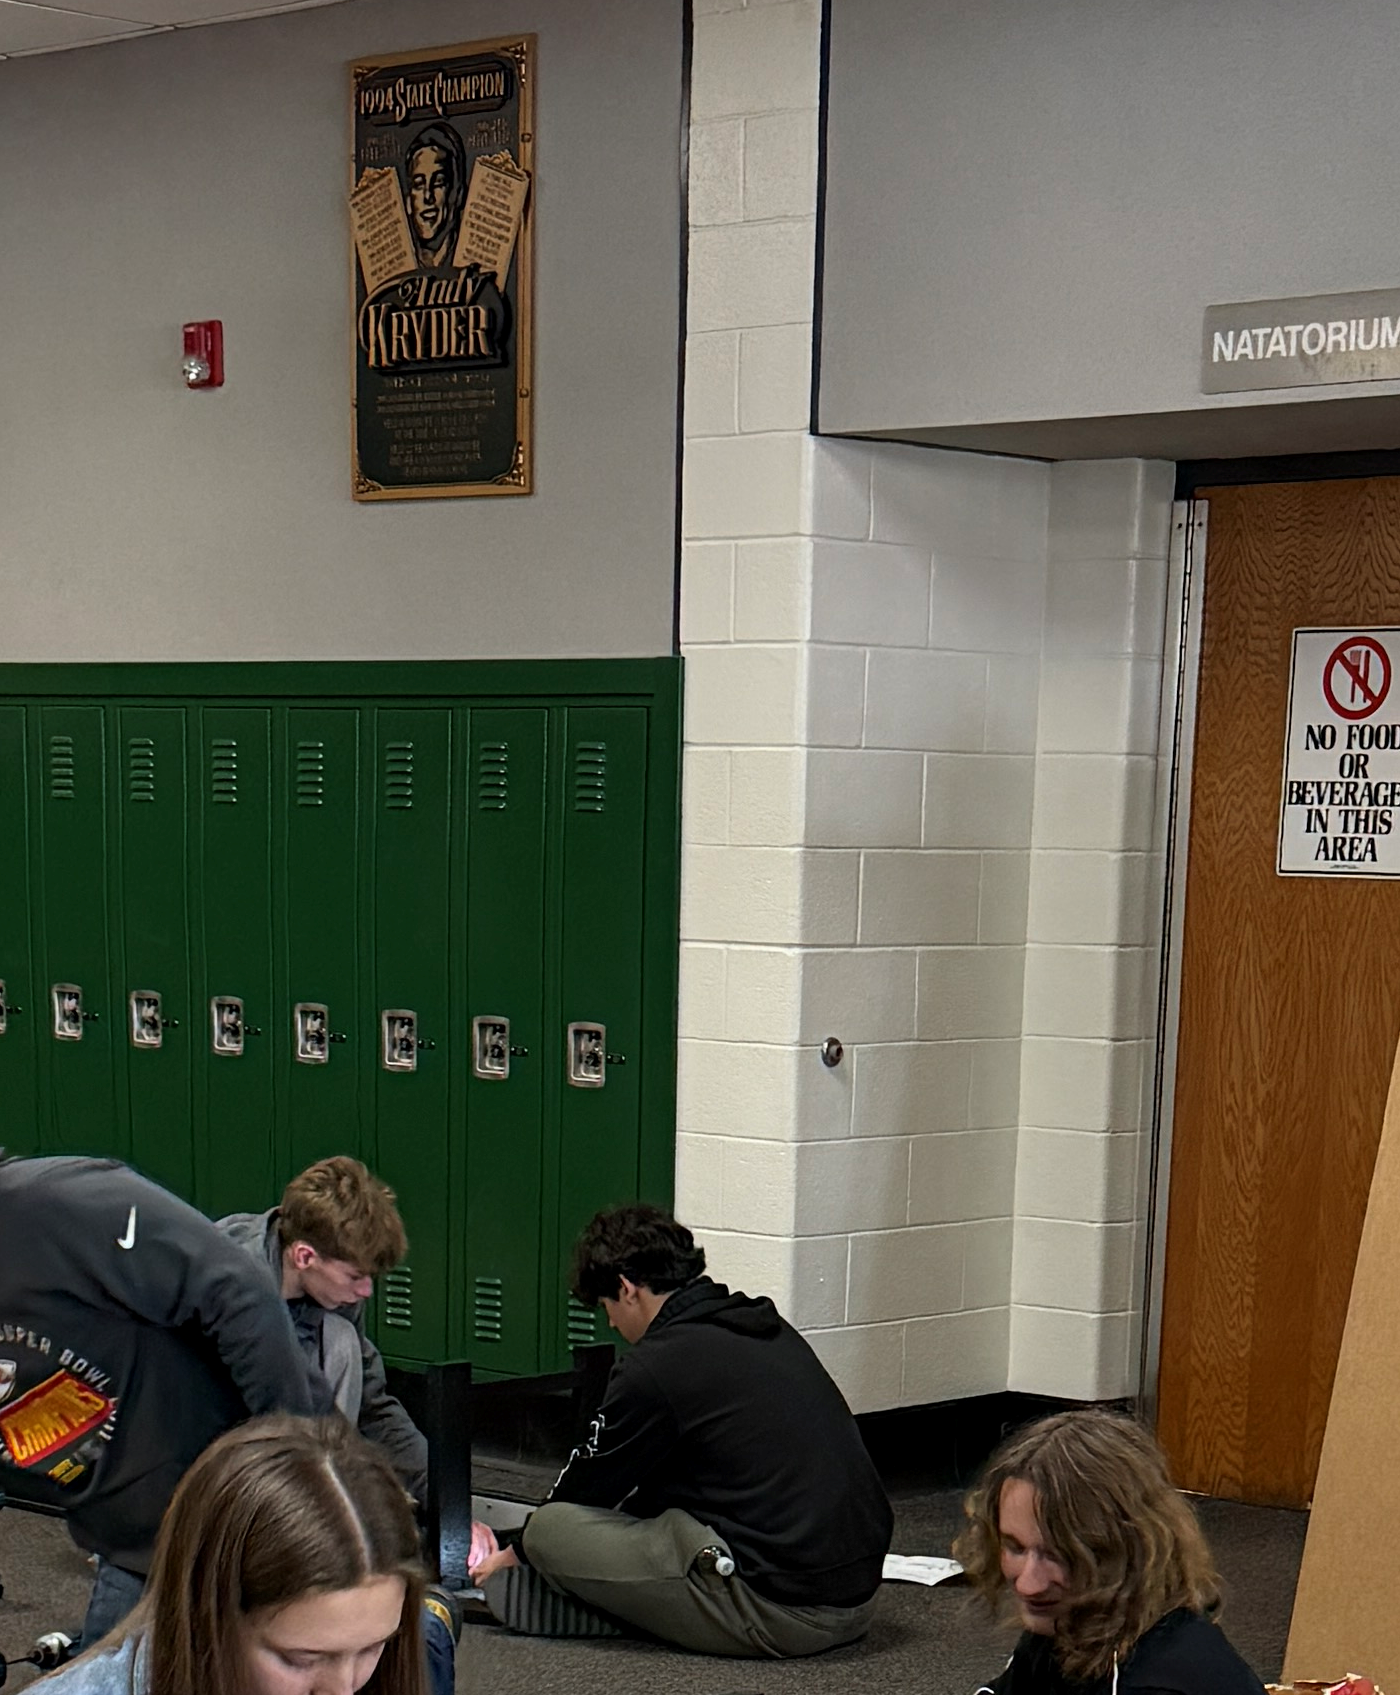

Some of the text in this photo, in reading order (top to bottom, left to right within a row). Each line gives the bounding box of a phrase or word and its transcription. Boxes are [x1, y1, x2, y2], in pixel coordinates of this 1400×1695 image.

[360, 87, 394, 115] 1994
[434, 71, 505, 116] CHAMPION
[397, 268, 495, 308] Andy
[367, 303, 494, 369] KRYDER
[1305, 724, 1337, 750] NO
[1338, 753, 1370, 779] OR
[1305, 809, 1392, 835] IN THIS
[1314, 836, 1378, 862] AREA
[59, 1348, 112, 1392] BOWL
